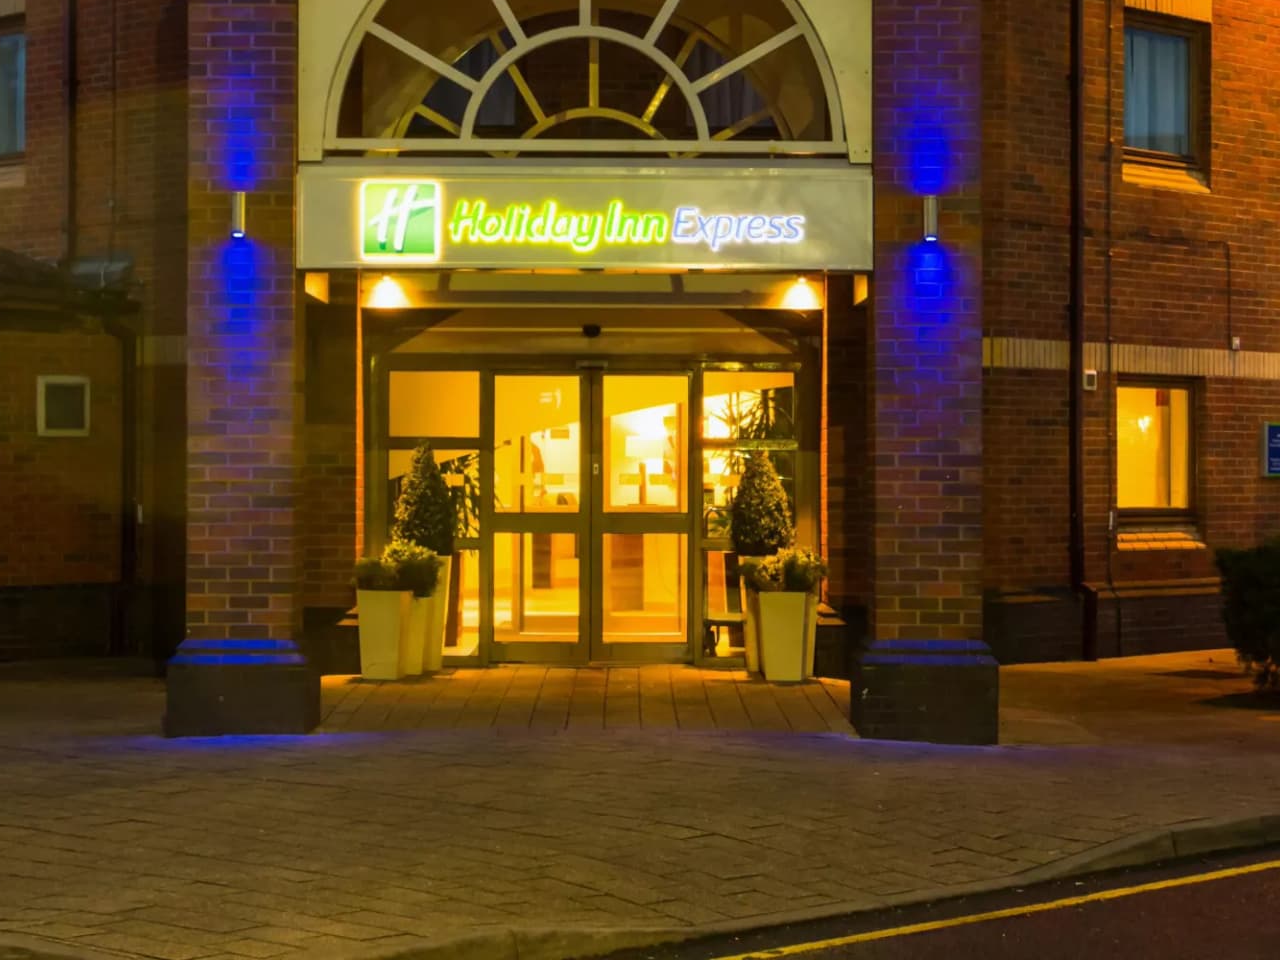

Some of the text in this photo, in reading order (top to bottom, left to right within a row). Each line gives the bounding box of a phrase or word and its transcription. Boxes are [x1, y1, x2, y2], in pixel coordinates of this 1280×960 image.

[369, 185, 436, 253] H
[449, 200, 805, 252] Holiday Inn Express
